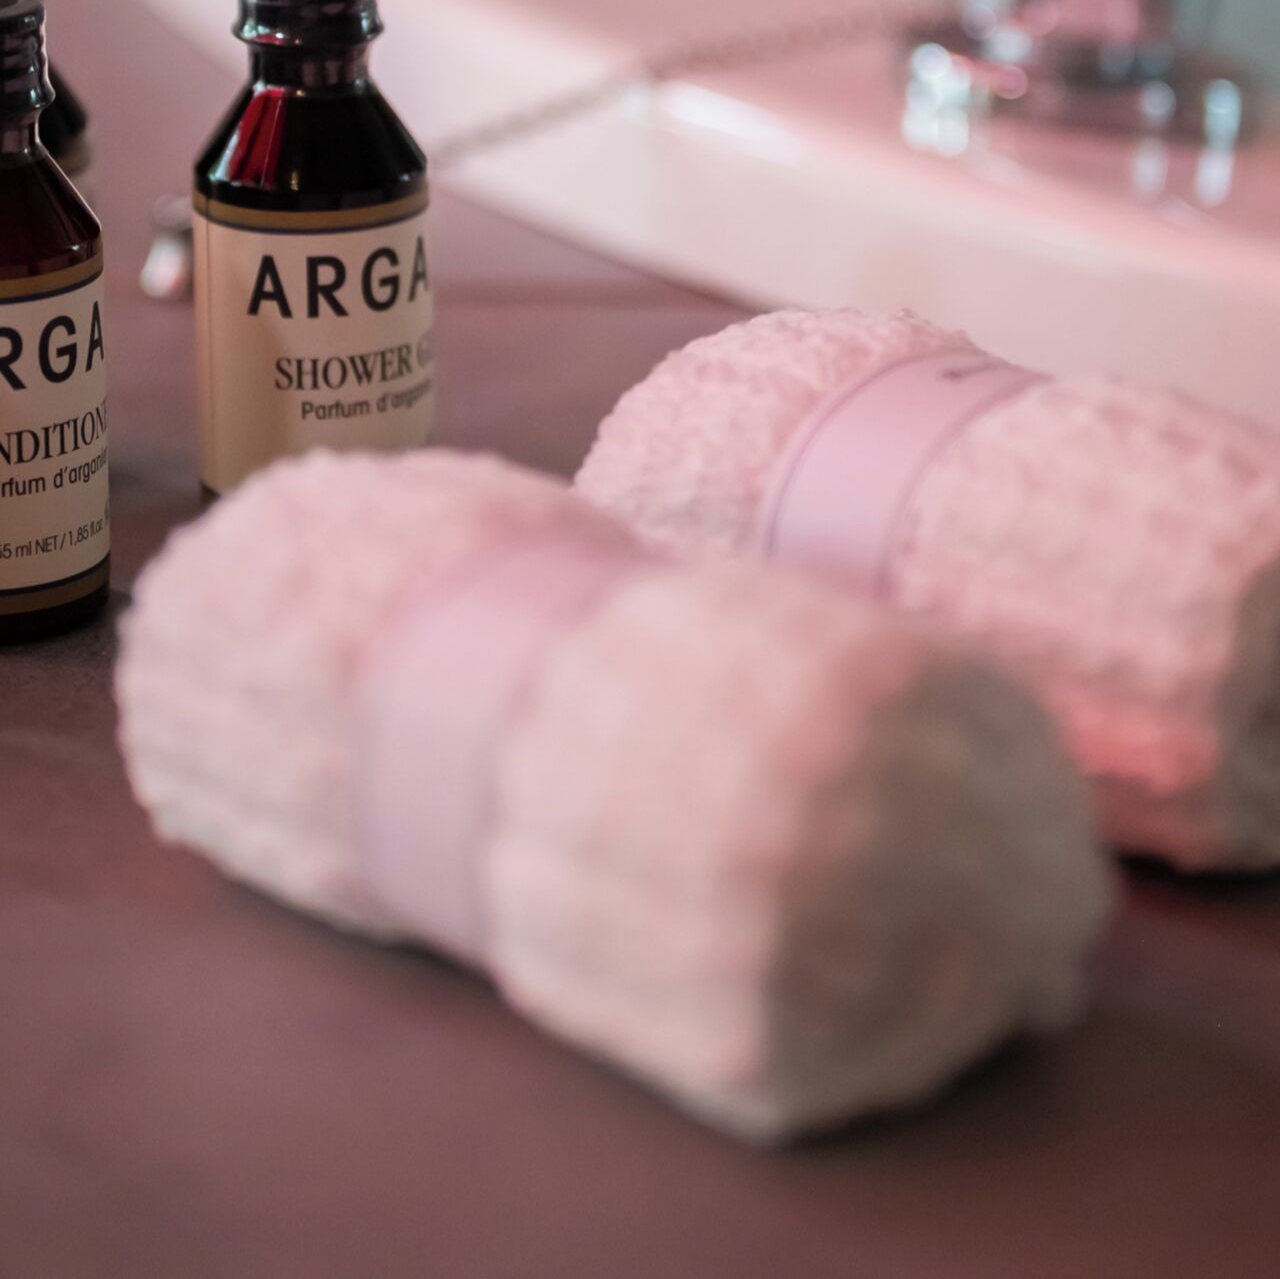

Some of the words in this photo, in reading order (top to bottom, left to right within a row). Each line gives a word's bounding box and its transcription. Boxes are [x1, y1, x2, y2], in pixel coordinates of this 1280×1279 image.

[247, 234, 429, 319] ARGA
[274, 343, 413, 391] SHOWER
[300, 399, 370, 420] Parfum
[15, 540, 32, 558] ml
[35, 534, 59, 555] NET
